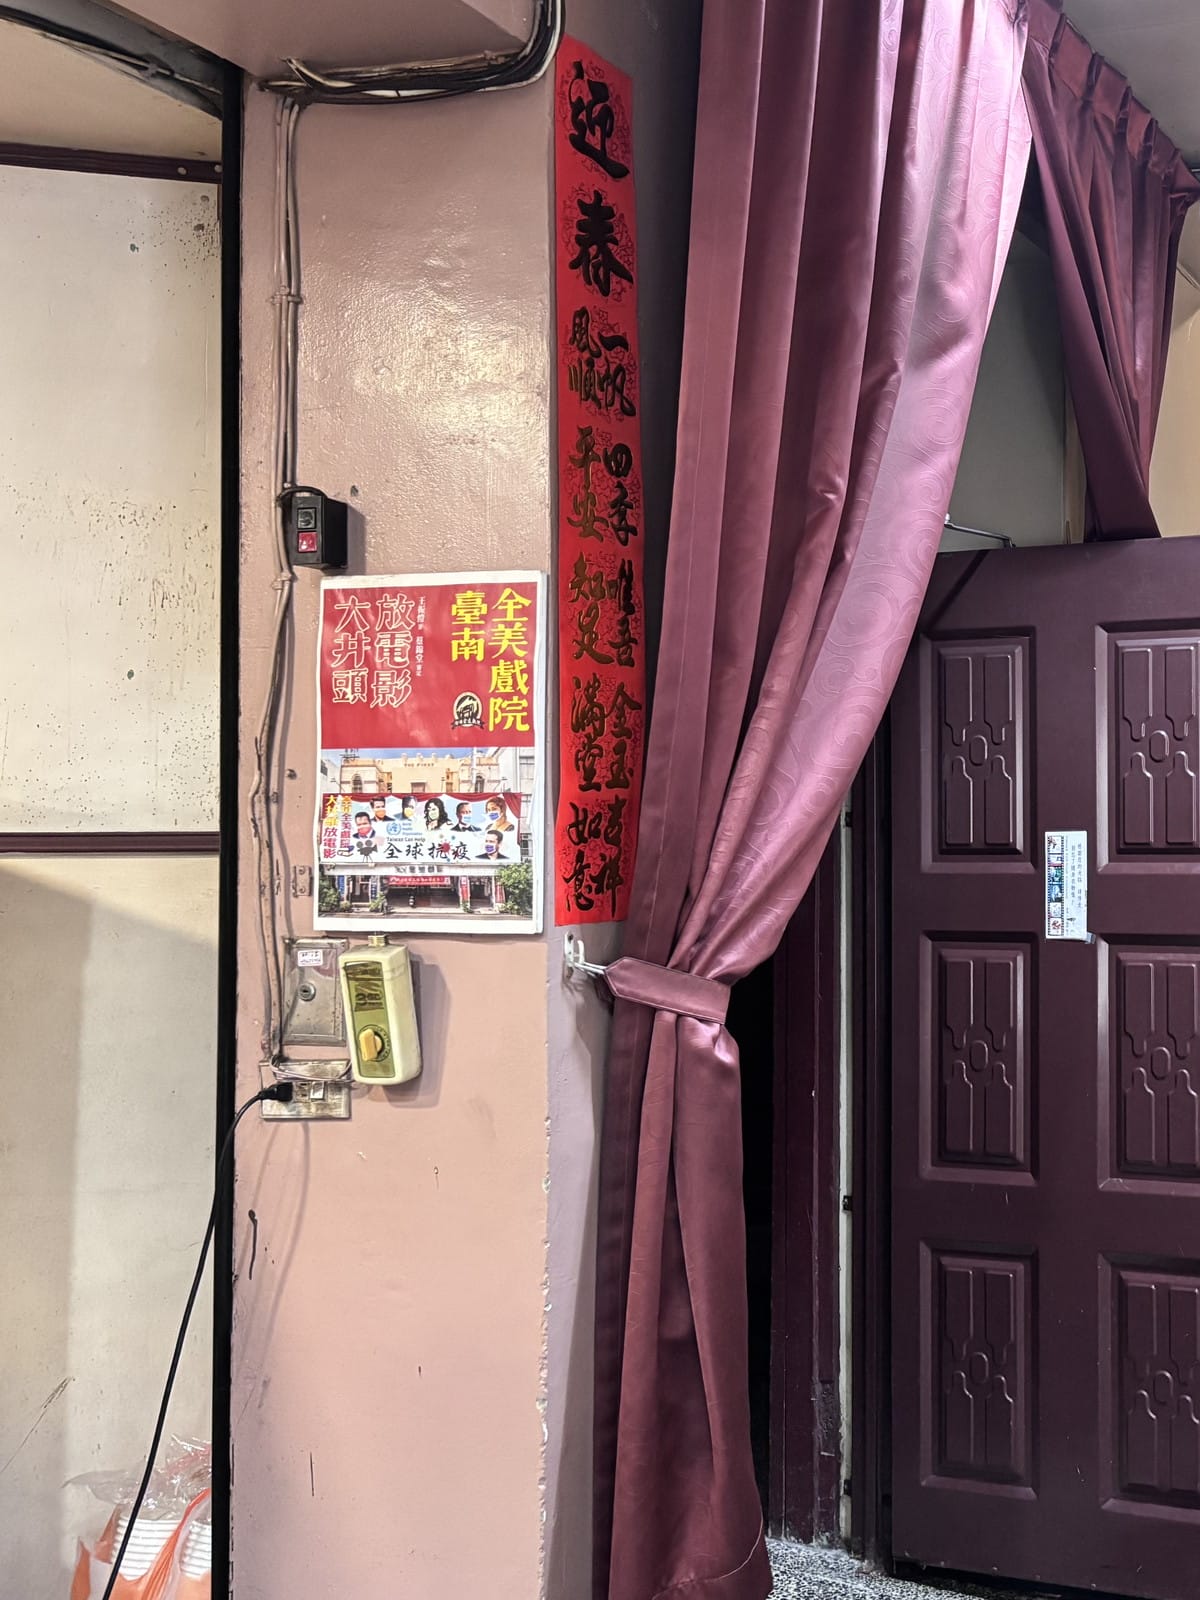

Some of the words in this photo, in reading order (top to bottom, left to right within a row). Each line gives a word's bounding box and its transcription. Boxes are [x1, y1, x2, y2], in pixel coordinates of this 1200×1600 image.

[569, 61, 634, 297] 迎春
[331, 594, 371, 705] 大井頭
[370, 593, 416, 709] 放電影
[451, 590, 488, 662] 臺南
[488, 587, 532, 732] 全美戲院
[383, 841, 471, 861] 全球抗疫
